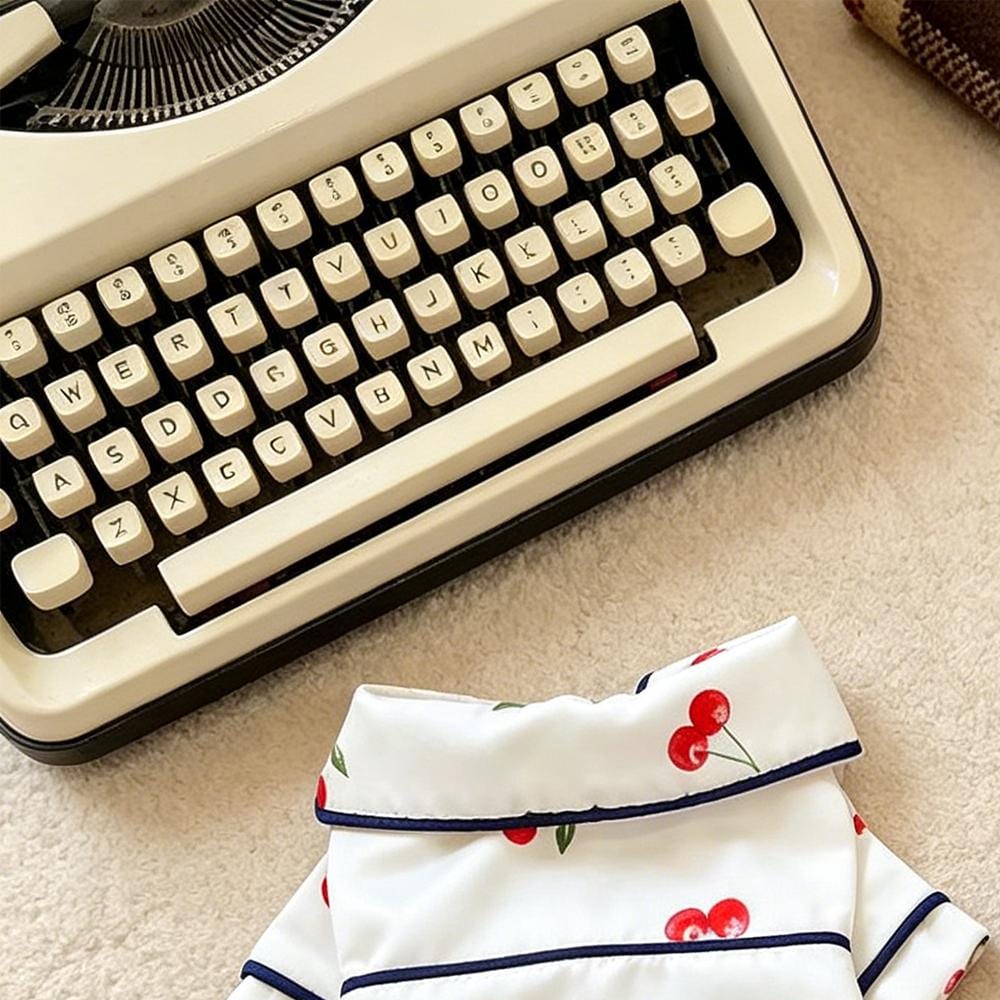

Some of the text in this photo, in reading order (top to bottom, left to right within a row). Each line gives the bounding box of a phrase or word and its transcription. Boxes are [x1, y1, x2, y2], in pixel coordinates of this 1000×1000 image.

[54, 472, 72, 490] A
[106, 446, 124, 463] S
[160, 418, 177, 436] D
[213, 390, 230, 408] D
[370, 315, 389, 333] H
[426, 290, 438, 308] J
[470, 262, 491, 284] K
[60, 384, 82, 404] W
[115, 360, 133, 380] E
[171, 333, 189, 351] R
[224, 305, 240, 325] T
[381, 232, 398, 250] U
[481, 184, 499, 202] O
[531, 160, 548, 178] O
[109, 517, 127, 538] Z
[163, 486, 185, 510] X
[270, 436, 287, 454] C
[319, 409, 336, 428] V
[373, 387, 390, 404] B
[421, 360, 442, 381] N
[472, 335, 495, 358] M
